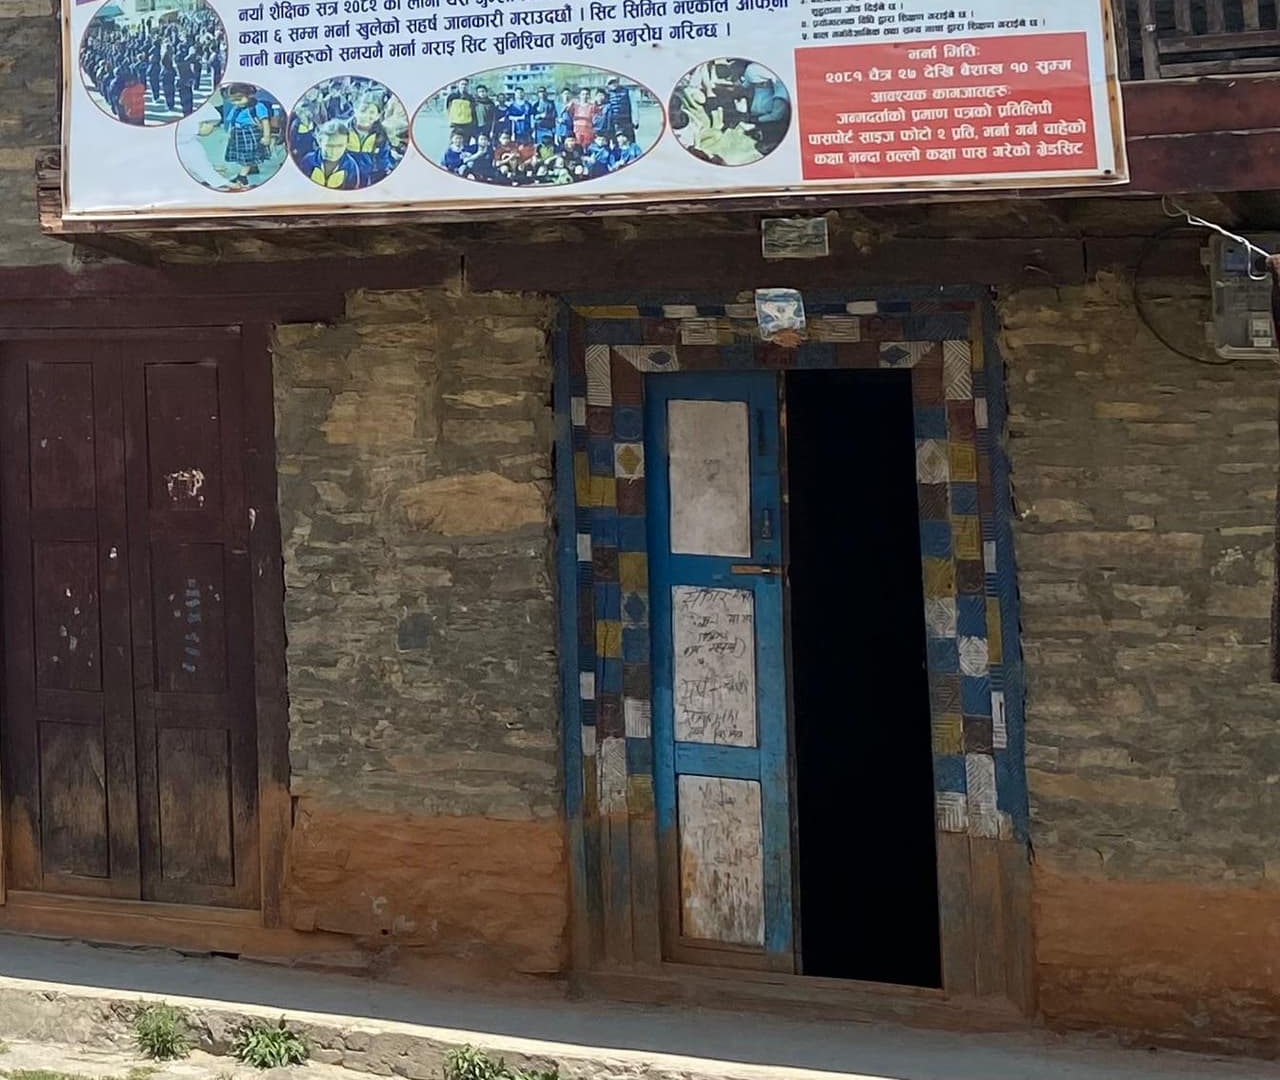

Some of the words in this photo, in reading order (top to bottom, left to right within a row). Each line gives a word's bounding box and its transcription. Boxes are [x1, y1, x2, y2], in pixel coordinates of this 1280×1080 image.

[238, 29, 269, 45] कक्षा
[273, 29, 282, 44] ६
[288, 26, 319, 43] सम्म
[323, 19, 350, 40] भर्ना
[355, 15, 401, 41] खुलेको
[405, 13, 438, 33] सहर्ष
[443, 8, 505, 32] जानकारी
[589, 1, 617, 20] सिट
[269, 0, 311, 21] शैक्षिक
[315, 1, 339, 17] सत्र
[239, 48, 269, 68] नानी
[338, 39, 384, 63] समयमै
[388, 38, 417, 58] भर्ना
[461, 34, 487, 54] सिट
[493, 30, 555, 55] सुनिश्चित
[611, 25, 663, 44] अनुरोध
[669, 20, 718, 40] गरिन्छ
